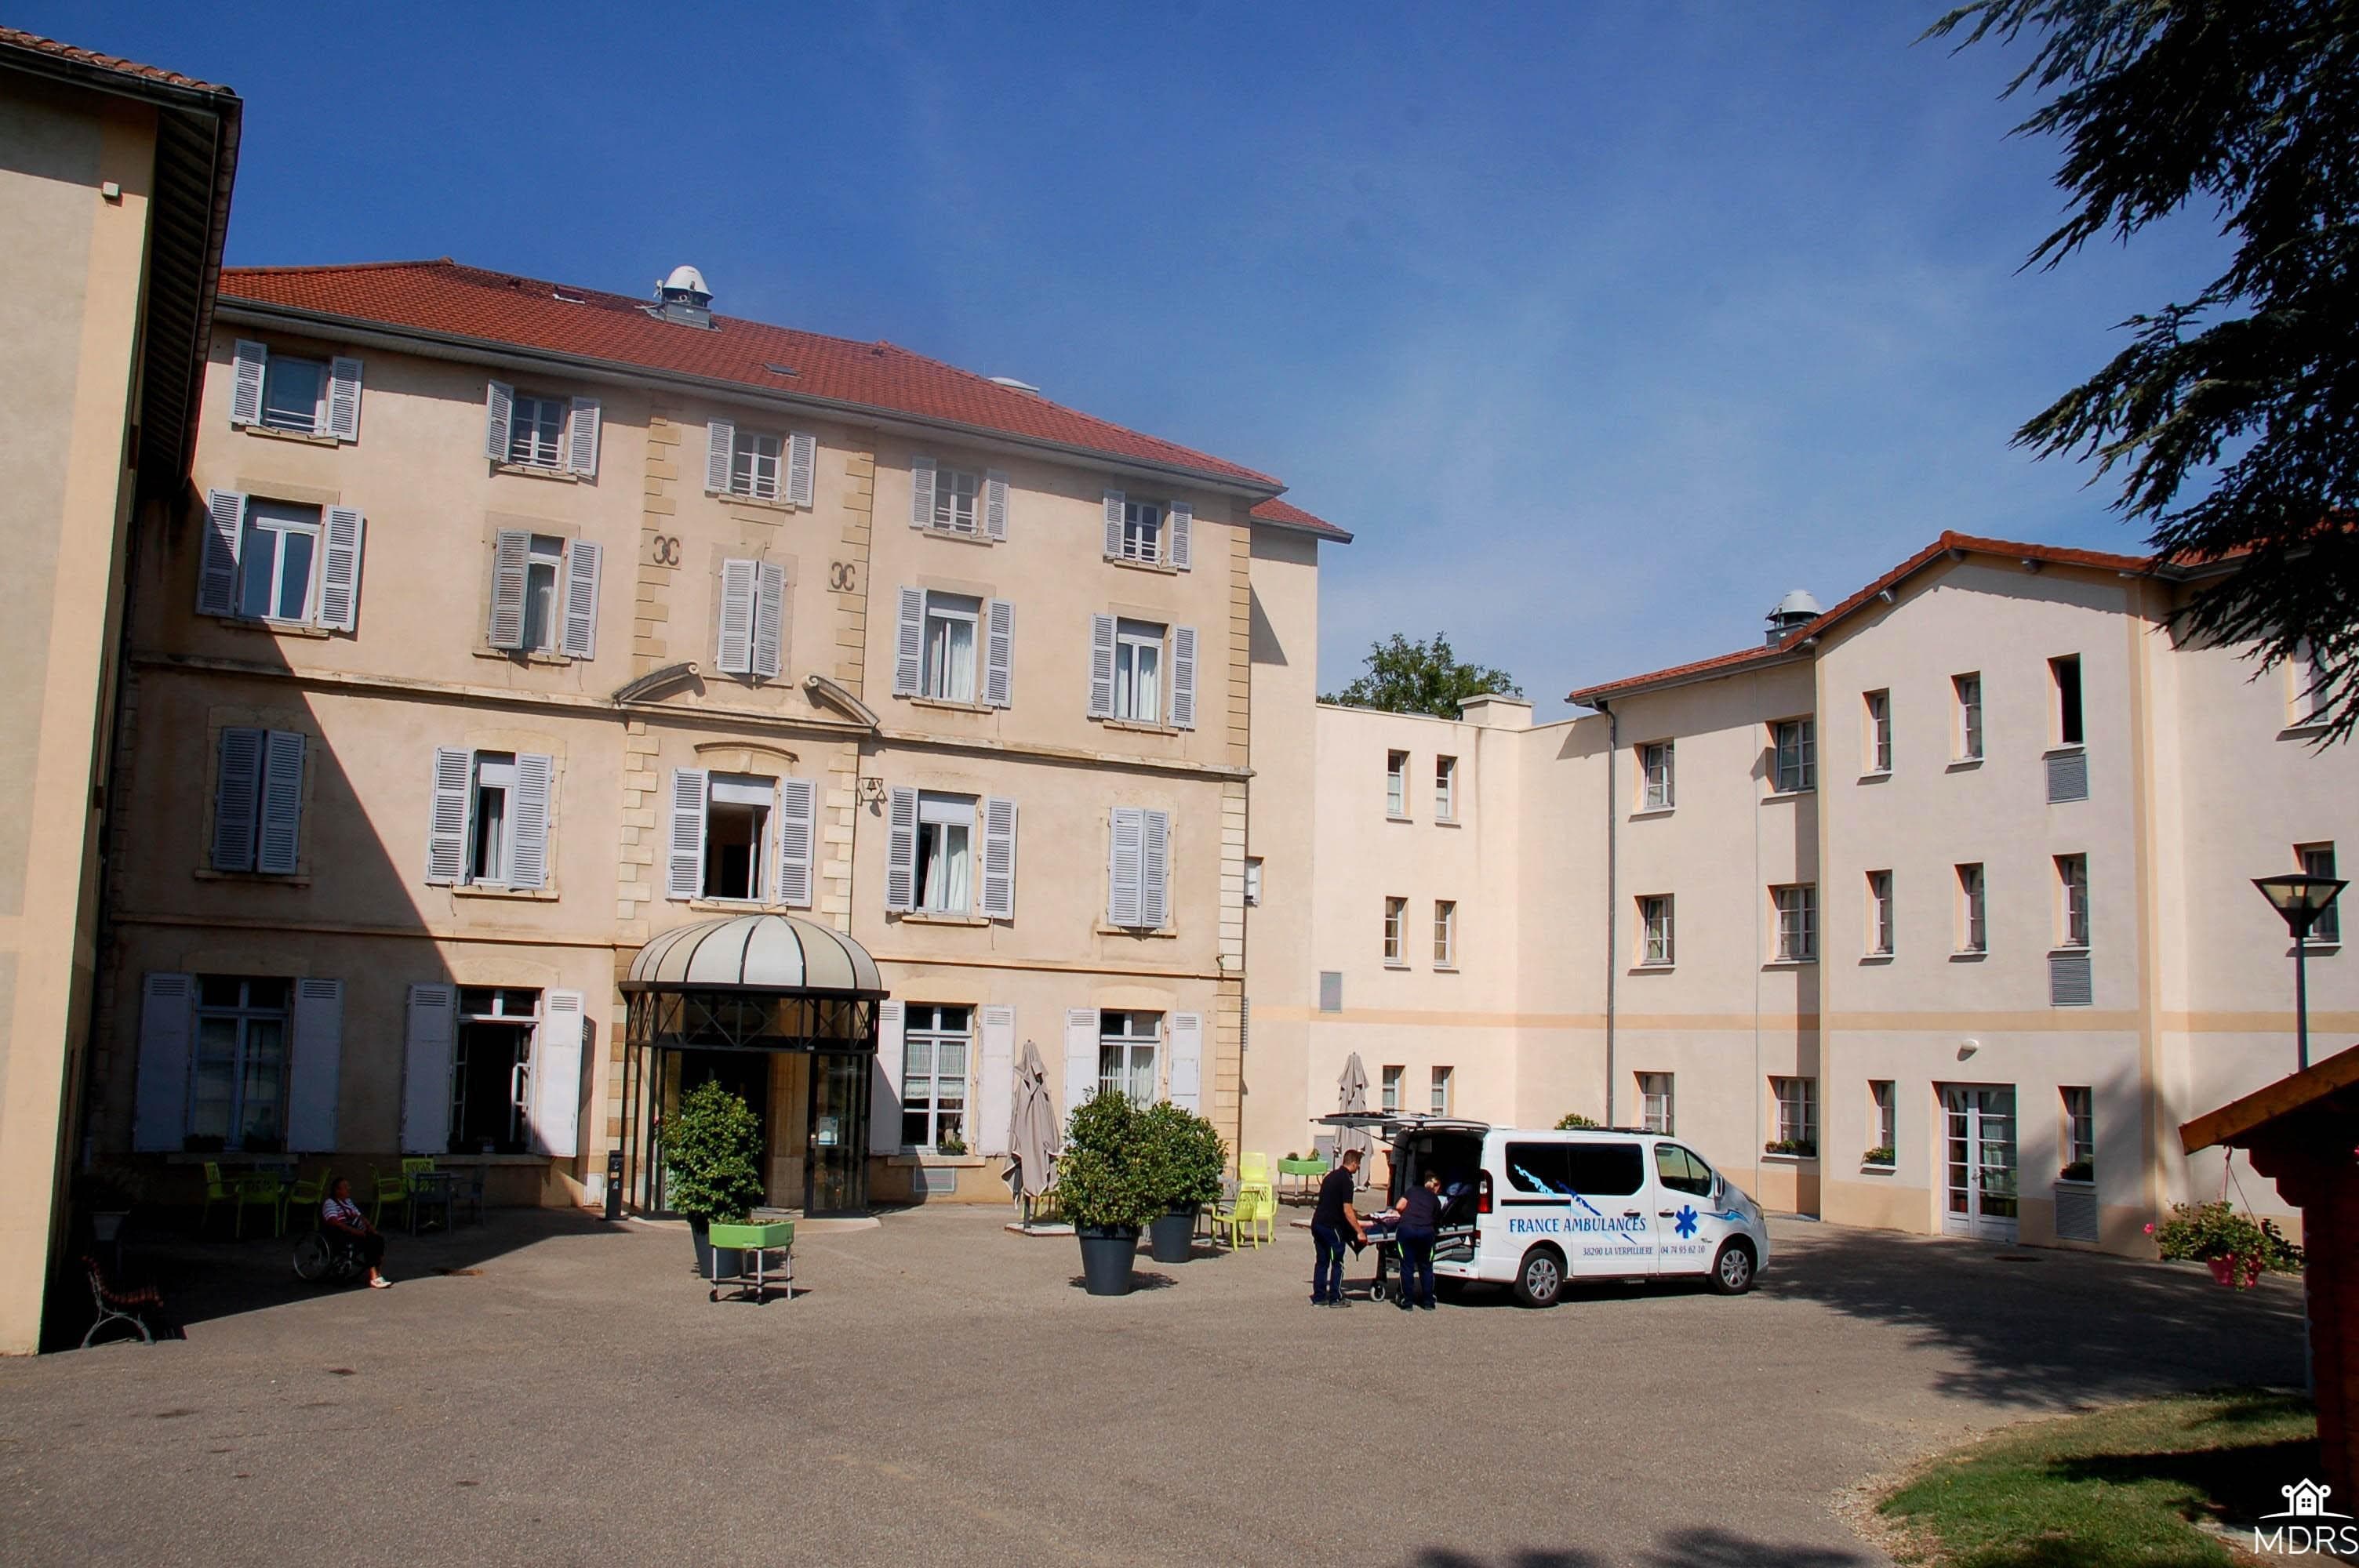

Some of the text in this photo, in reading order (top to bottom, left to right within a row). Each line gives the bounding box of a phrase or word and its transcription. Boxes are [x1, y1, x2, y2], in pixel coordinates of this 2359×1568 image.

[1509, 1217, 1646, 1232] FRANCE AMBULANCES
[1660, 1246, 1669, 1254] 04
